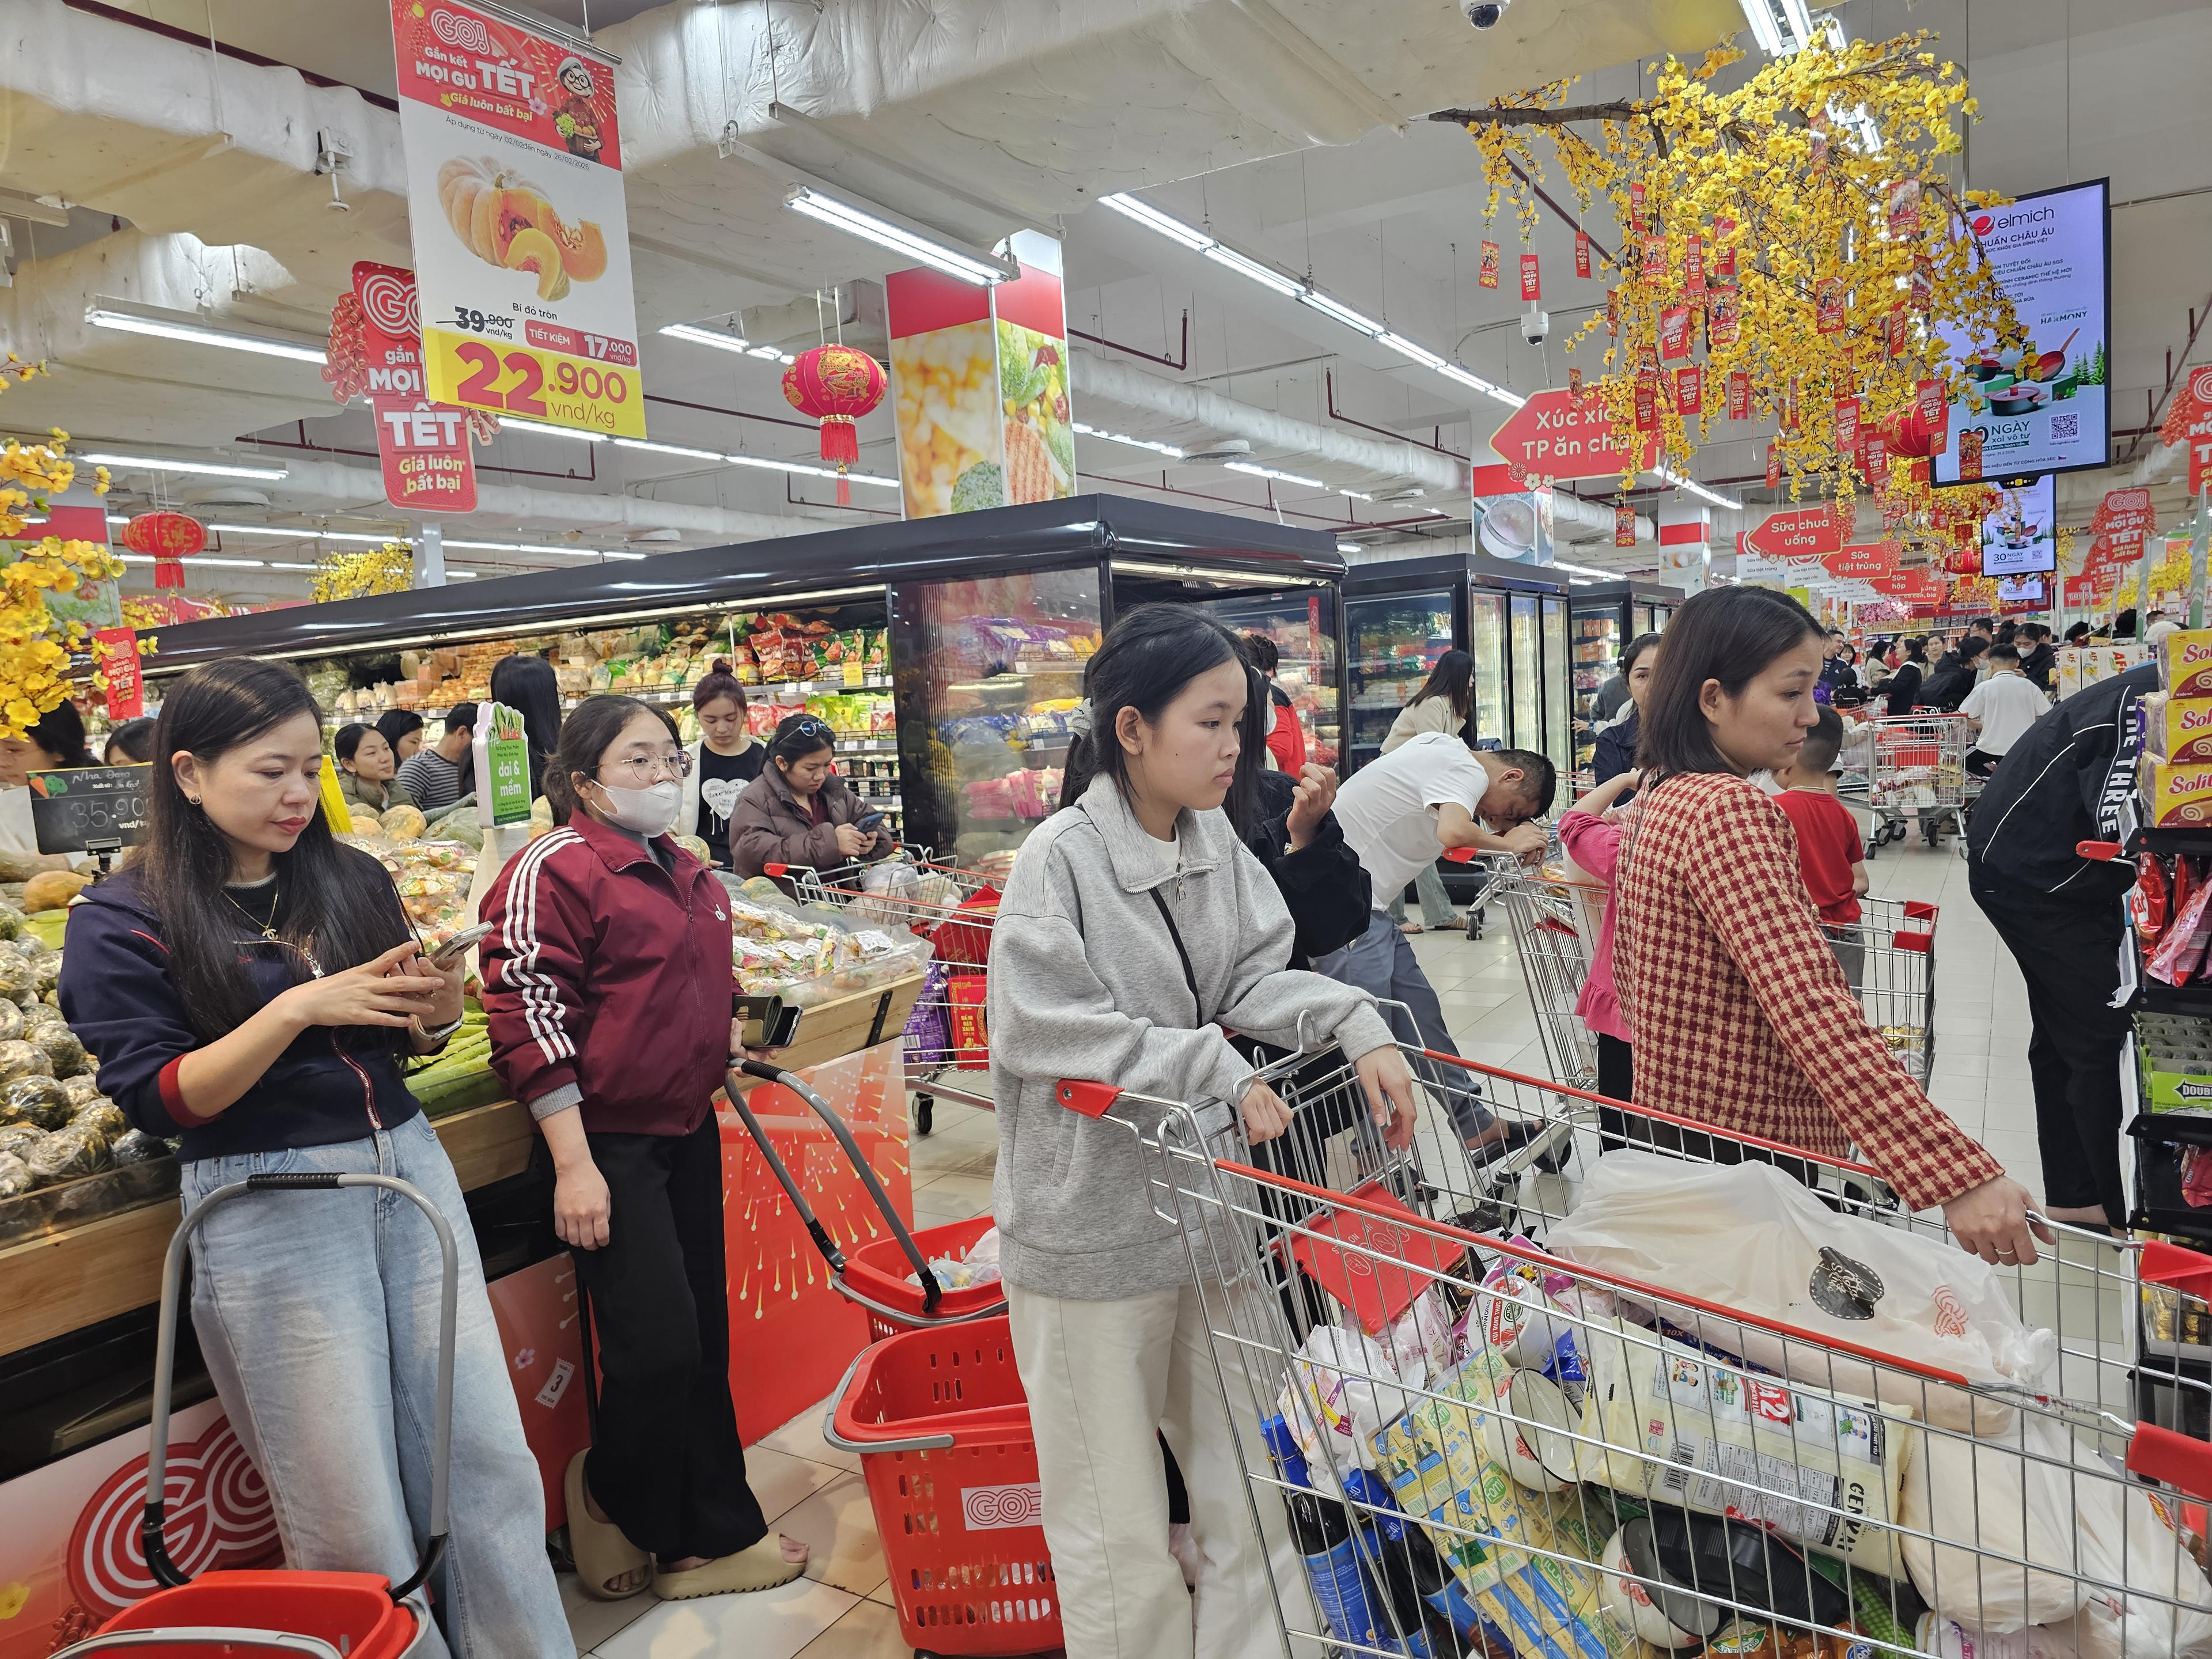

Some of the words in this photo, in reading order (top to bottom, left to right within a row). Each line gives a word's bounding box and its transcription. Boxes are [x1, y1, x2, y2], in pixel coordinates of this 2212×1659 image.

[431, 9, 490, 55] GO!
[425, 46, 447, 63] Gắn
[450, 53, 468, 68] kết
[415, 60, 449, 83] MỌI
[451, 70, 476, 89] GU
[475, 58, 535, 99] TẾT
[450, 92, 468, 105] Giá
[469, 97, 494, 112] luôn
[496, 103, 514, 116] bất
[516, 109, 533, 122] bại
[446, 115, 457, 126] Áp
[457, 120, 476, 132] dụng
[477, 126, 484, 135] từ
[486, 131, 502, 142] ngày
[536, 147, 552, 157] ngày
[554, 153, 589, 170] 26/02/2026
[1998, 207, 2054, 229] elmich
[2010, 230, 2037, 243] CHÂU
[2041, 227, 2054, 236] ÂU
[2014, 274, 2039, 282] CERAMIC
[513, 302, 522, 313] Bí
[524, 304, 537, 316] đỏ
[539, 309, 558, 320] tròn
[486, 327, 513, 340] vnd/kg
[529, 327, 548, 341] TIẾT
[549, 332, 570, 346] KIỆM
[385, 345, 414, 365] gắn
[609, 353, 631, 365] vnd/kg
[368, 367, 421, 396] MỌI
[1682, 390, 1696, 401] TẾT
[551, 402, 615, 429] vnd/kg
[1536, 408, 1578, 430] Xúc
[1923, 406, 1940, 418] TẾT
[384, 400, 461, 446] TẾT
[1840, 425, 1855, 435] TẾT
[1991, 421, 2031, 436] NGÀY
[1522, 440, 1549, 460] TP
[1554, 435, 1581, 457] ăn
[399, 454, 425, 474] Giá
[429, 454, 464, 472] luôn
[1869, 457, 1883, 467] TẾT
[407, 473, 434, 494] bất
[437, 474, 461, 494] bại
[2108, 491, 2147, 512] GO!
[1771, 521, 1795, 533] Sữa
[1799, 519, 1830, 529] chua
[2105, 520, 2126, 531] MỌI
[2128, 516, 2144, 525] GU
[1785, 533, 1816, 546] uống
[2109, 526, 2141, 545] TẾT
[1850, 551, 1870, 560] Sữa
[1994, 553, 2006, 562] 30
[1838, 562, 1854, 573] tiệt
[1856, 561, 1881, 571] trùng
[499, 760, 512, 777] dai
[514, 760, 520, 776] &
[500, 778, 521, 797] mềm
[2100, 756, 2138, 834] THREE
[70, 797, 149, 828] 35.90
[1666, 1328, 1684, 1337] 10X
[1444, 1424, 1457, 1437] CANXI
